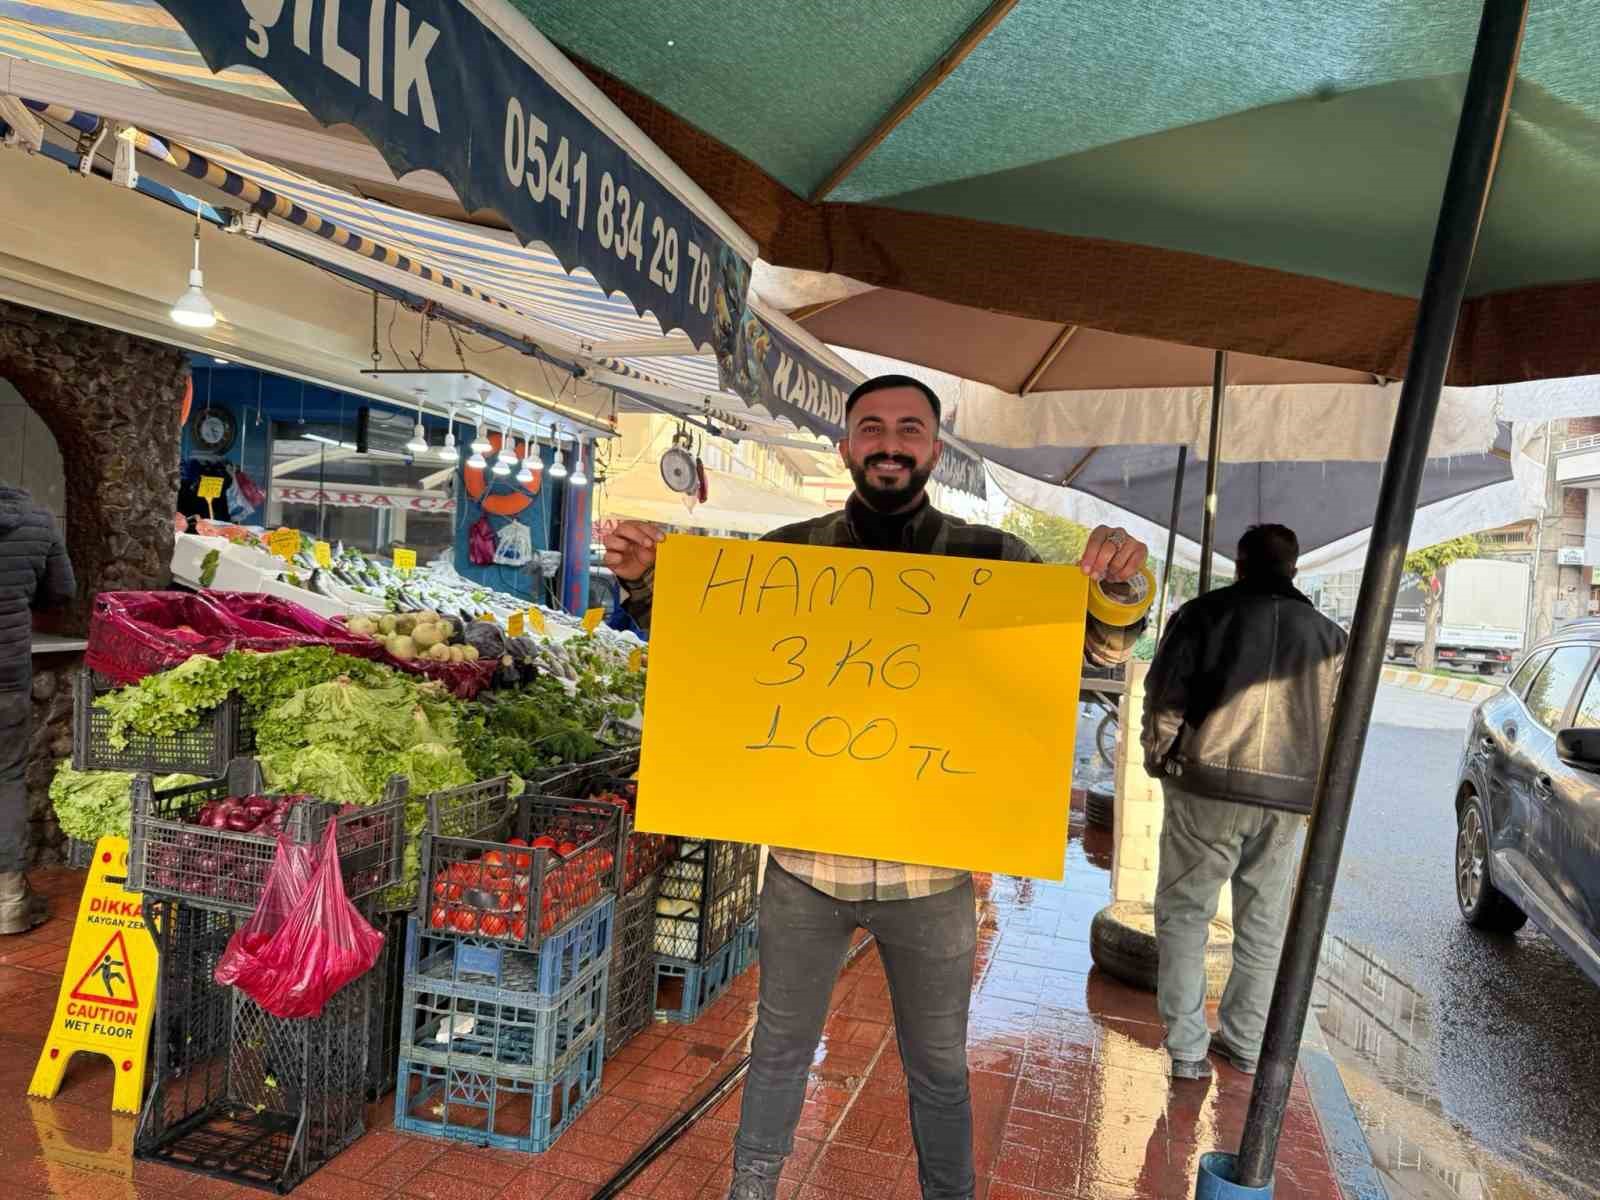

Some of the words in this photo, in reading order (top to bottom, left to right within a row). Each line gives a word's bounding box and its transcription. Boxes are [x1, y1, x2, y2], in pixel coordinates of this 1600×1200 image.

[241, 0, 441, 134] LIK
[504, 96, 588, 232] 0541
[596, 171, 646, 272] 834
[649, 215, 679, 294] 29
[687, 240, 711, 315] 78
[280, 488, 392, 506] KARA
[753, 635, 808, 686] 3
[827, 637, 922, 690] KG
[744, 704, 898, 761] 100
[908, 745, 977, 781] TL
[87, 914, 125, 927] KAYGAN
[64, 1018, 90, 1032] WET
[93, 1023, 133, 1039] FLOOR
[67, 1002, 138, 1026] CAUTION
